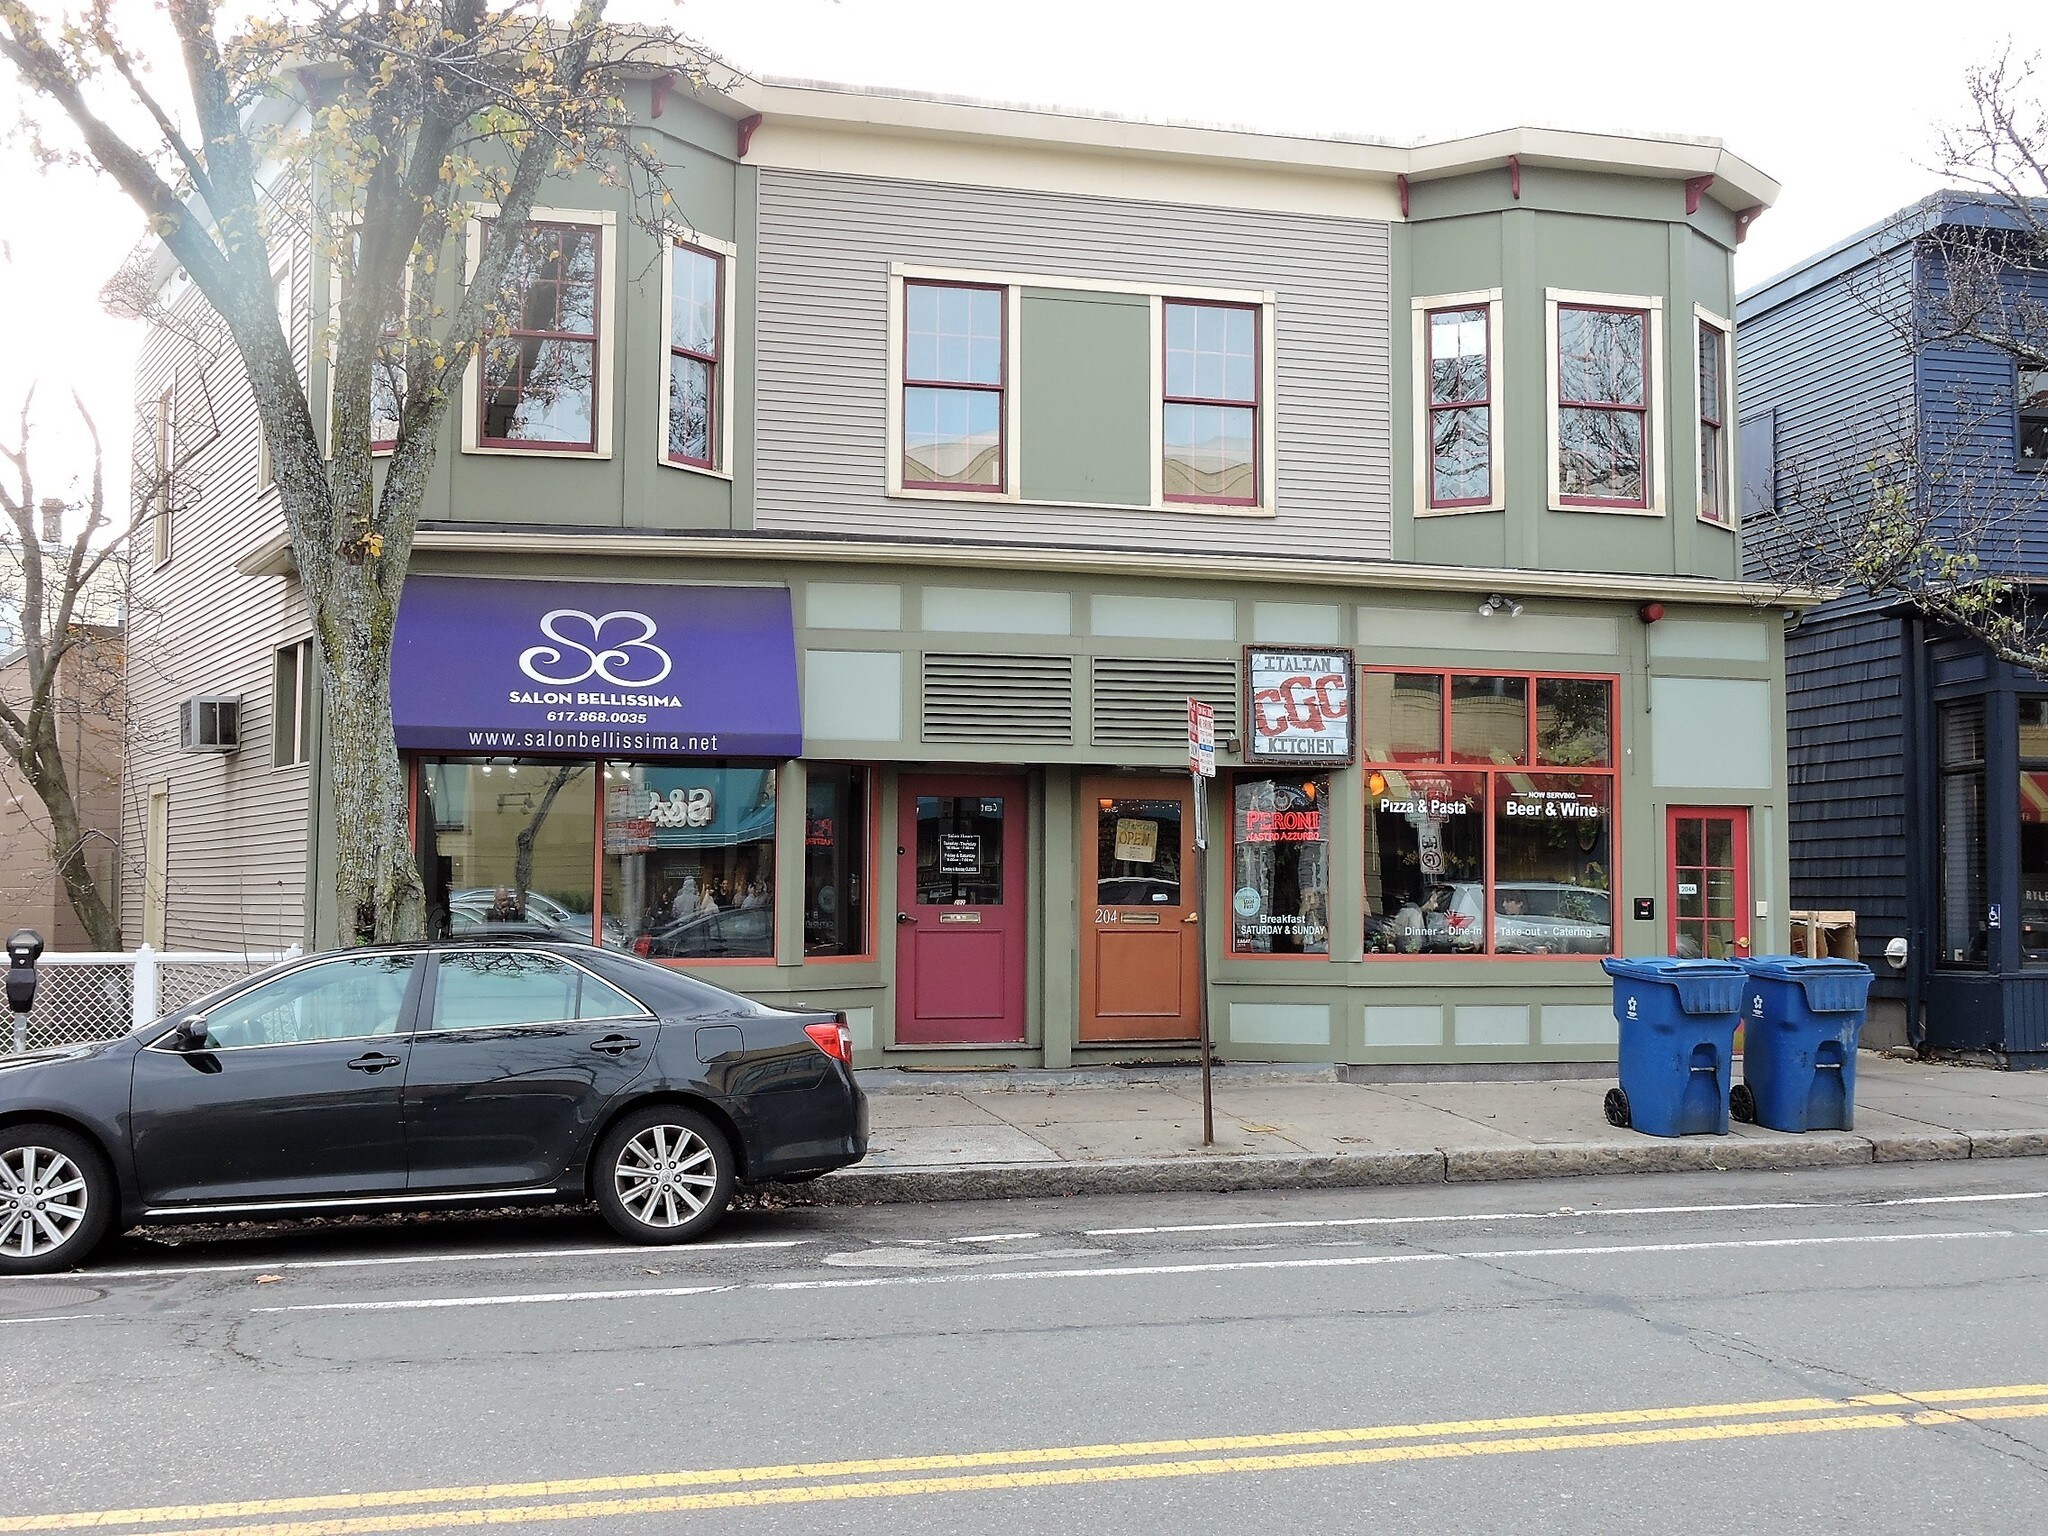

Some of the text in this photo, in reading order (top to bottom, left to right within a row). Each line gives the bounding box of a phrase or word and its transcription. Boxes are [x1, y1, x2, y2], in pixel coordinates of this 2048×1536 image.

[1264, 656, 1331, 672] ITALIAN
[509, 691, 683, 708] SALON BELLISSIMA
[1255, 674, 1347, 736] CGC
[546, 711, 647, 724] 617.868.0035
[469, 728, 718, 751] www.salonbellissima.net
[1268, 738, 1334, 754] KITCHEN
[1528, 791, 1576, 799] NOW SERVING
[1380, 798, 1414, 813] Pizza
[1417, 799, 1428, 814] &
[1431, 799, 1467, 815] Pasta
[1506, 801, 1541, 816] Beer
[1545, 802, 1557, 816] &
[1560, 802, 1598, 817] Wine
[1246, 811, 1320, 830] PERONI
[1119, 831, 1150, 846] OPEN
[1246, 831, 1320, 841] NASTRO AZZURRO
[1094, 908, 1118, 924] 204
[1260, 914, 1306, 924] Breakfast
[1240, 925, 1325, 935] SATURDAY & SUNDAY
[1404, 926, 1592, 938] Dinner Dine-in Take-out Catering
